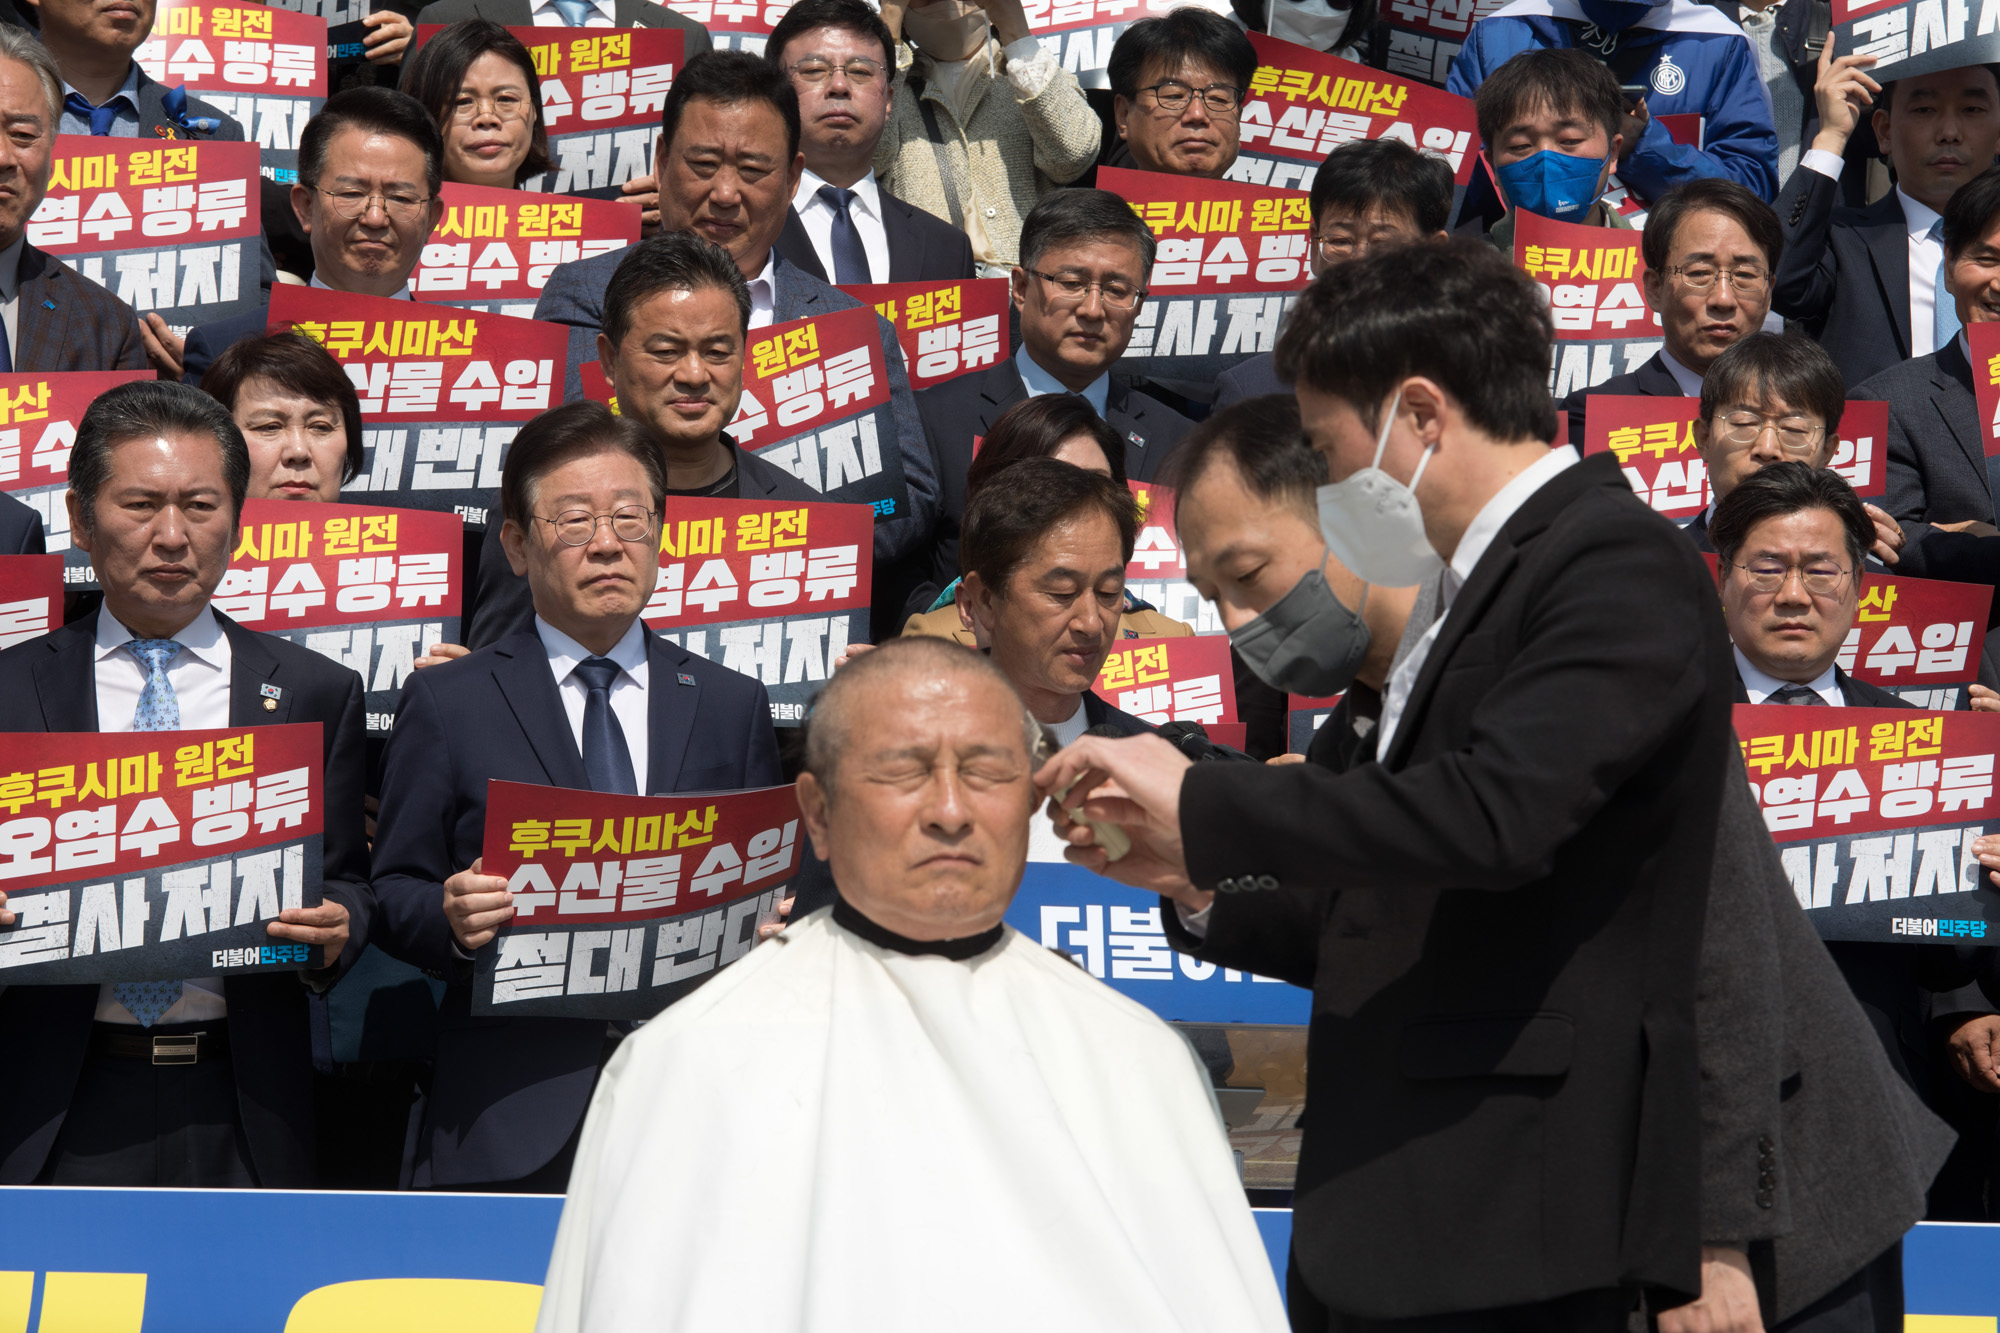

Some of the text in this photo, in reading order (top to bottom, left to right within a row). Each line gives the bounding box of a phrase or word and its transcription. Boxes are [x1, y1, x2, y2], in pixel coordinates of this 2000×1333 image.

[211, 7, 273, 39] 원전
[223, 40, 316, 87] 방류
[569, 33, 631, 73] 원전
[581, 63, 673, 121] 방류
[1249, 65, 1408, 117] 후쿠시마산
[1240, 100, 1373, 155] 수산물
[128, 146, 197, 186] 원전
[142, 178, 247, 237] 방류
[434, 203, 583, 238] 시마 원전
[1250, 197, 1311, 232] 원전
[116, 243, 241, 311] 저지
[409, 242, 519, 292] 염수
[1255, 234, 1317, 283] 방
[1524, 245, 1638, 280] 후쿠시마
[906, 285, 961, 330] 원전
[1220, 296, 1297, 354] 저
[752, 322, 820, 379] 원전
[917, 314, 1000, 378] 방류
[449, 359, 554, 411] 수입
[772, 345, 875, 427] 방류
[323, 514, 398, 554] 원전
[736, 508, 808, 552] 원전
[336, 553, 449, 612] 방류
[748, 544, 858, 607] 방류
[1100, 644, 1170, 691] 원전
[1865, 621, 1974, 676] 수입
[1741, 716, 1944, 775] 쿠시마 원전
[0, 733, 254, 815] 후쿠시마 원전
[1748, 753, 1995, 832] 염수 방류
[0, 766, 310, 880] 오염수 방류
[509, 805, 719, 858] 후쿠시마산
[509, 818, 799, 917] 수산물 수입
[1845, 826, 1984, 905] 저지
[0, 843, 304, 970] 결사 저지
[1892, 917, 1987, 938] 더불어민주당
[212, 946, 310, 968] 더불어민주당
[492, 927, 645, 1004] 절대
